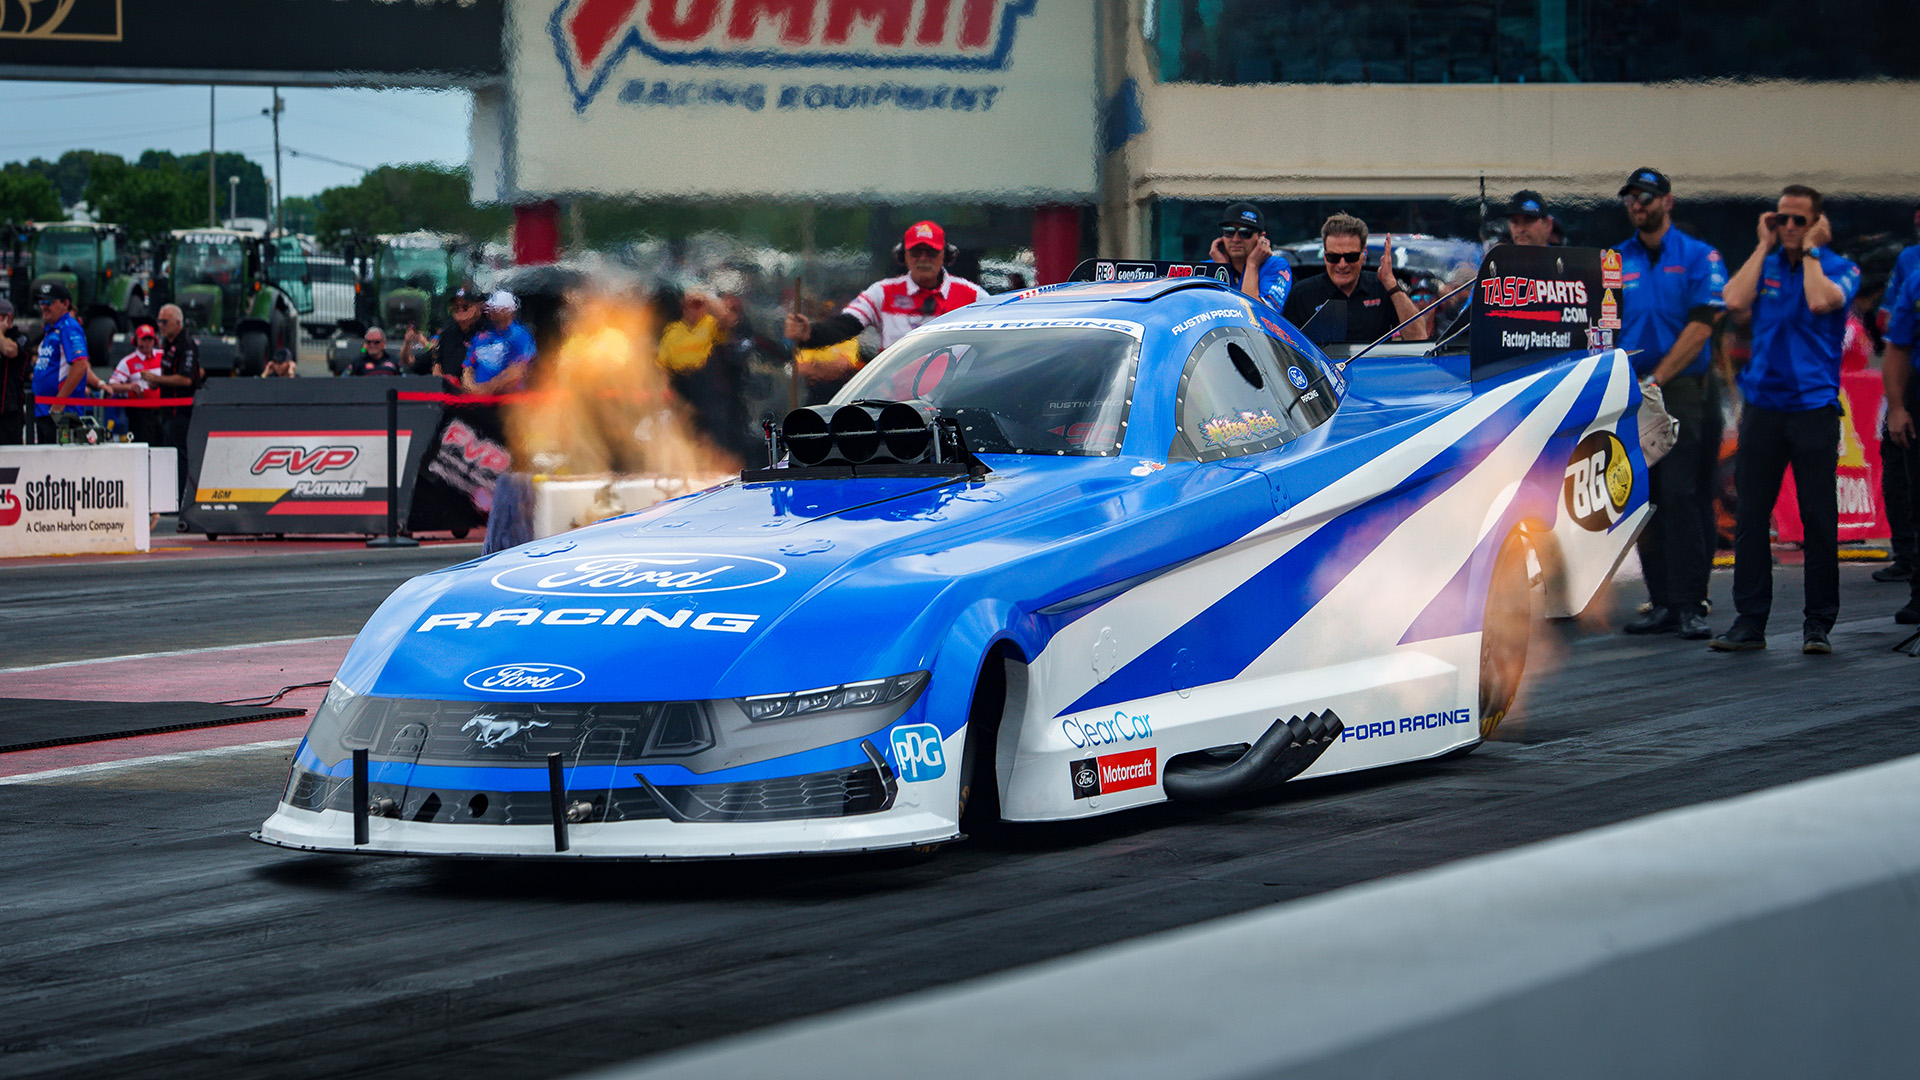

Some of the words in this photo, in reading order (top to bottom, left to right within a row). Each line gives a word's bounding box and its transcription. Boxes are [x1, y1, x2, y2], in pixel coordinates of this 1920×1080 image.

[1000, 321, 1134, 332] RACING
[1171, 312, 1211, 336] AUSTIN
[1210, 309, 1243, 319] PROCK
[1561, 307, 1588, 323] .COM
[1502, 331, 1530, 350] Factory
[1531, 331, 1550, 347] Parts
[1551, 332, 1571, 348] Fast!
[1049, 401, 1091, 409] AUSTIN
[251, 447, 359, 475] FVP
[26, 474, 125, 517] safety-kleen
[211, 491, 232, 499] AGM
[292, 481, 367, 497] PLATINUM
[1564, 450, 1612, 522] BG
[26, 523, 32, 532] A
[34, 522, 55, 532] Clean
[57, 521, 87, 532] Harbors
[89, 520, 125, 533] Company
[537, 558, 735, 588] Ford
[416, 607, 760, 633] RACING
[482, 666, 564, 688] Ford
[1062, 711, 1152, 748] ClearCar
[1342, 720, 1395, 742] FORD
[1399, 708, 1470, 733] RACING
[1079, 771, 1094, 785] Ford
[1102, 758, 1152, 784] Motorcraft
